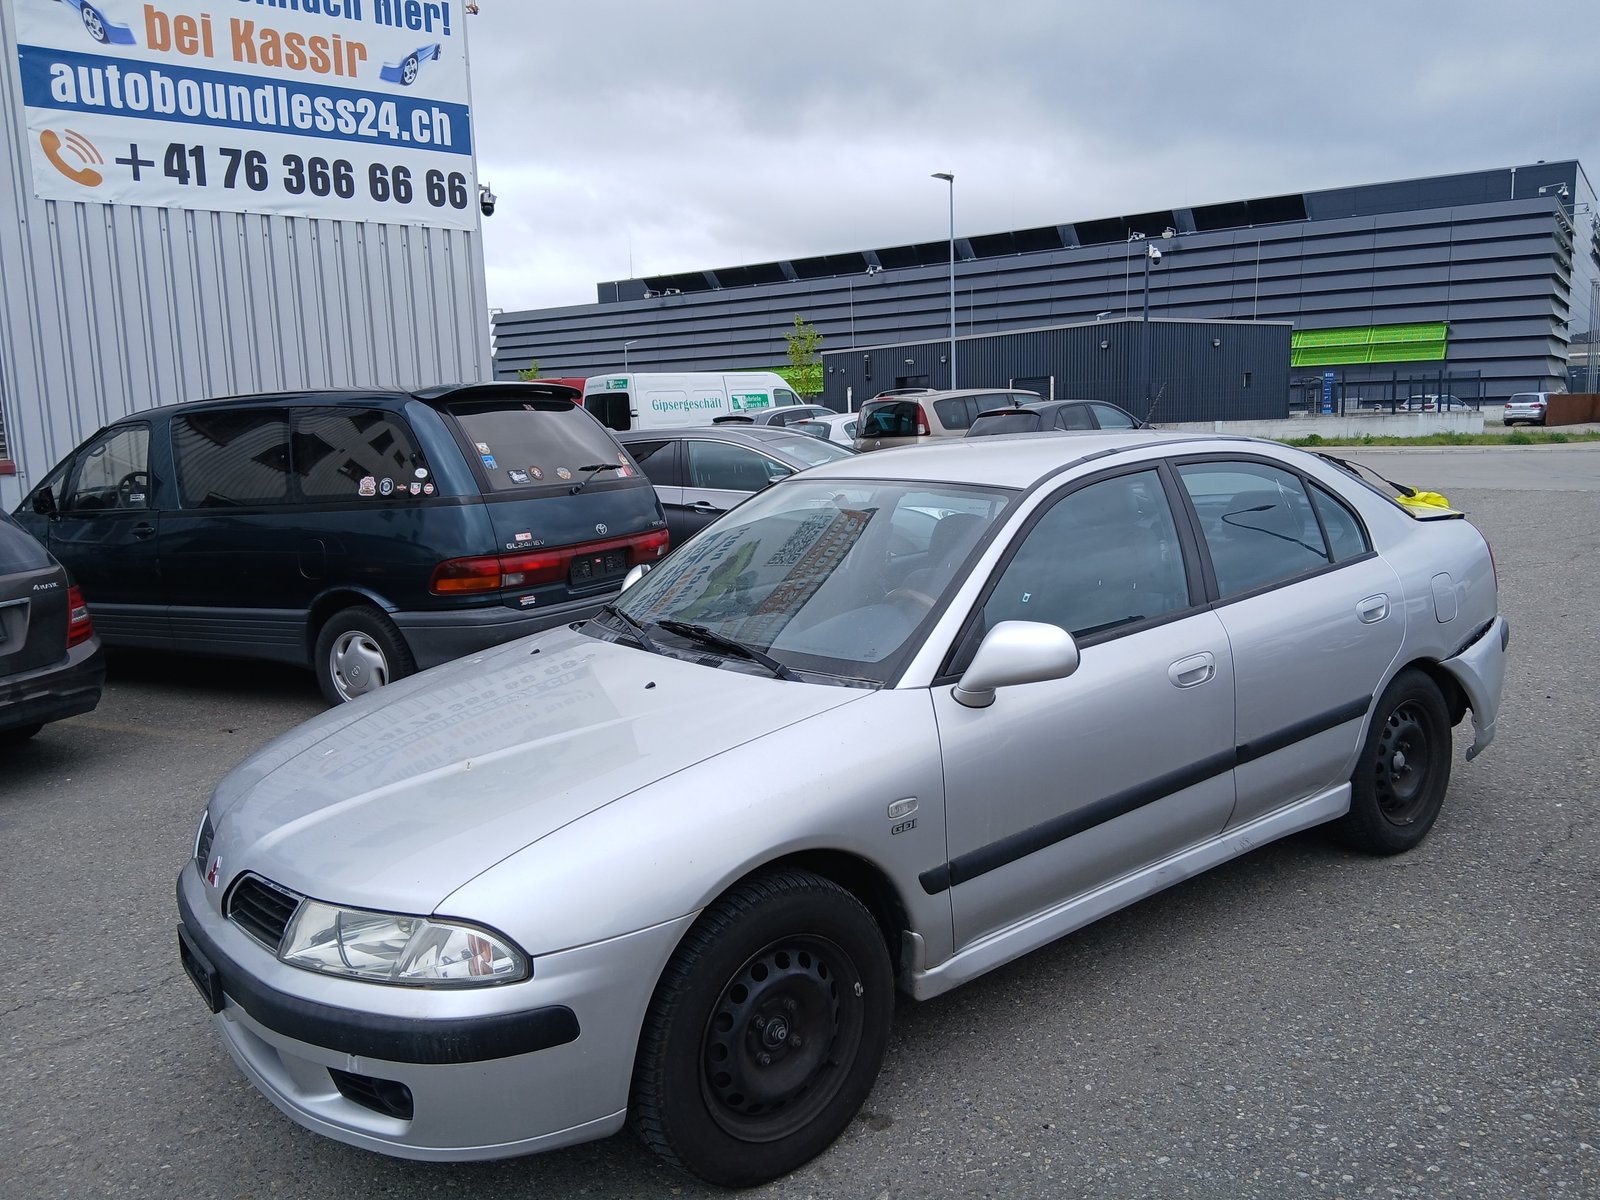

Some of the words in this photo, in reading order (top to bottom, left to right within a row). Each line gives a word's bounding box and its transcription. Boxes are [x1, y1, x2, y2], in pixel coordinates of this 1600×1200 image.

[144, 4, 214, 58] bei
[230, 18, 368, 78] Kassir
[50, 62, 452, 146] autoboundless24.ch
[219, 147, 269, 191] 76
[283, 154, 355, 200] 366
[368, 163, 413, 205] 66
[426, 169, 468, 210] 66
[652, 397, 722, 413] Gipsergeschäft
[891, 818, 918, 835] GDI
